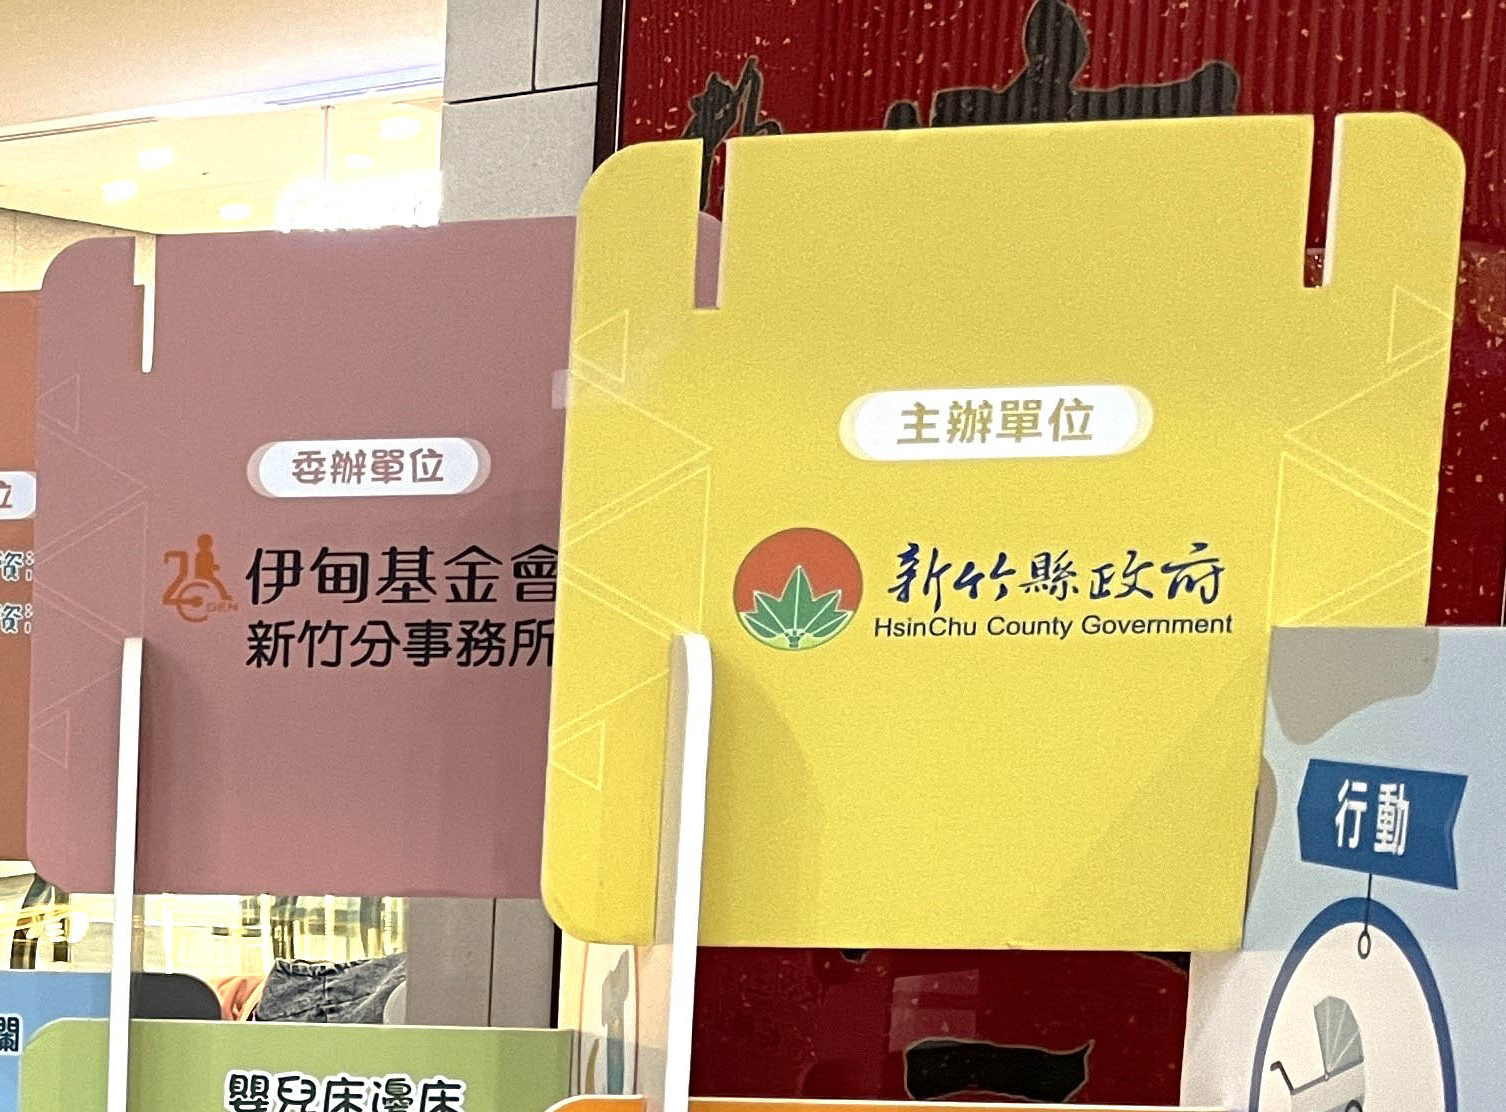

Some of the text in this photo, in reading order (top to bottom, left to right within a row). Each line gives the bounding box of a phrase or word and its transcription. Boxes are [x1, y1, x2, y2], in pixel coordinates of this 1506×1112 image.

[896, 397, 1094, 445] 主辦單位
[291, 448, 444, 484] 委辦單位
[245, 544, 558, 604] 伊甸基金會
[888, 542, 1225, 613] 新竹縣政府
[246, 618, 554, 668] 新竹分事務所
[875, 614, 1232, 639] HsinChu County Government
[1335, 778, 1410, 856] 行動
